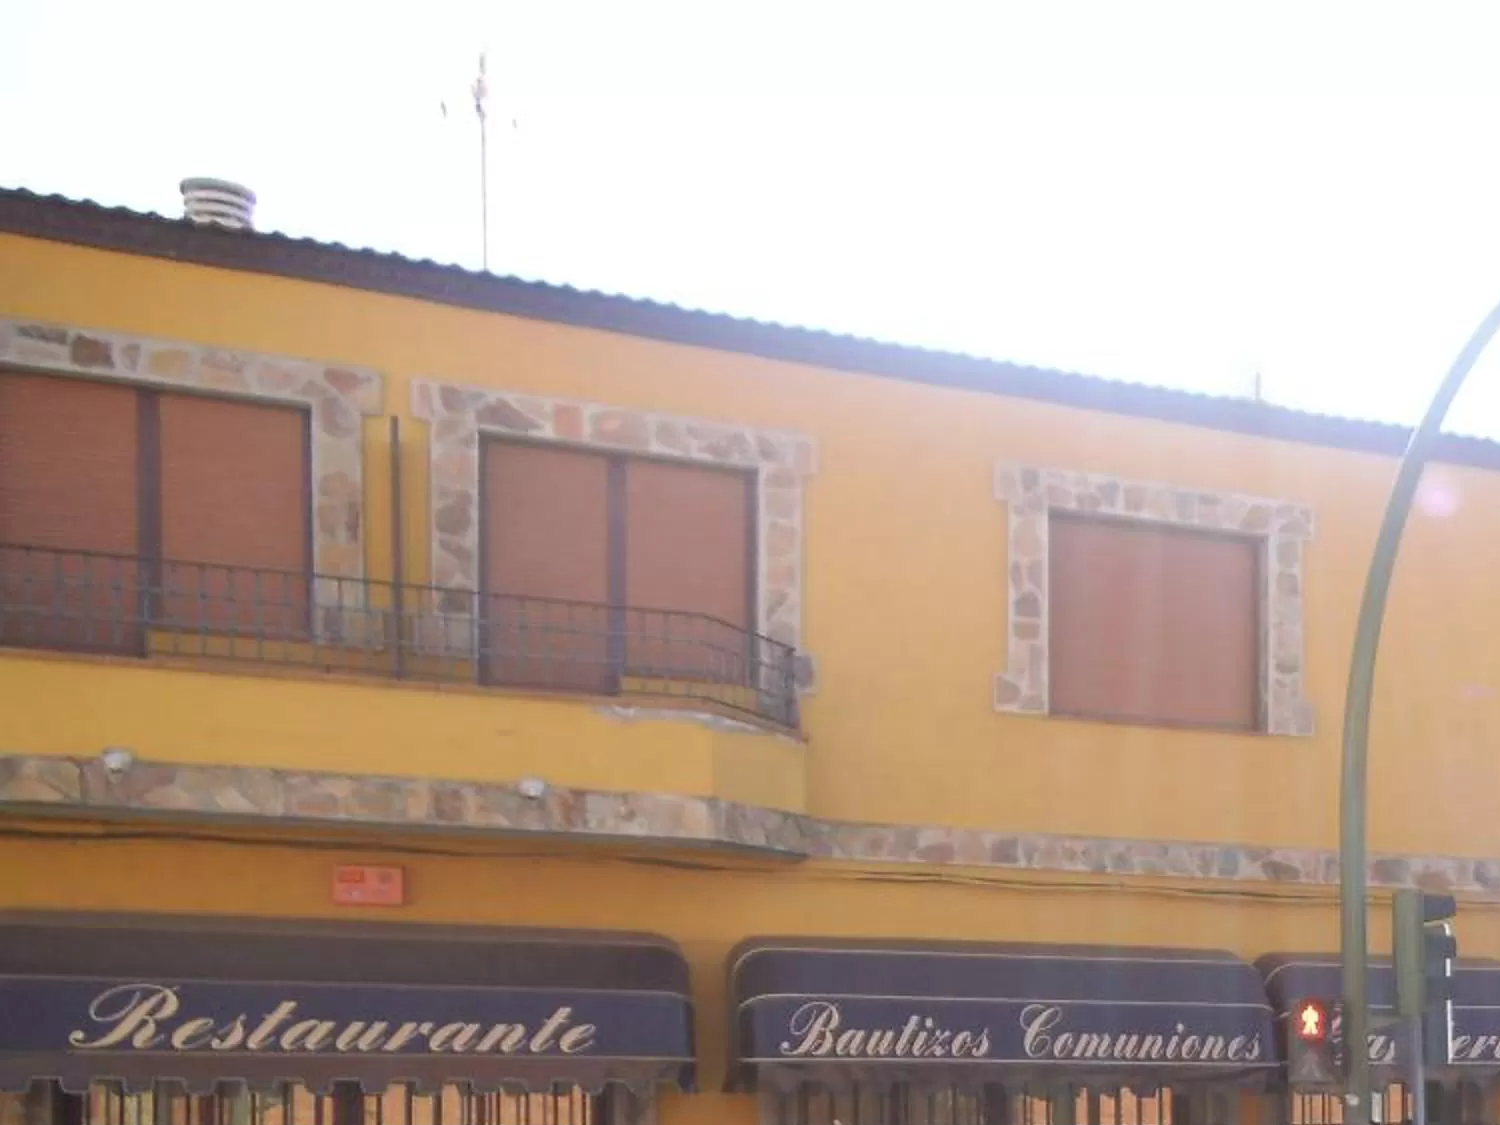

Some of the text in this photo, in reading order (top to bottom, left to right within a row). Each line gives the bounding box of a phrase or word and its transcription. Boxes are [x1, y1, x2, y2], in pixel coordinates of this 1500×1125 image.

[68, 983, 597, 1054] Restaurante
[779, 1001, 1263, 1062] Bautizos Comuniones
